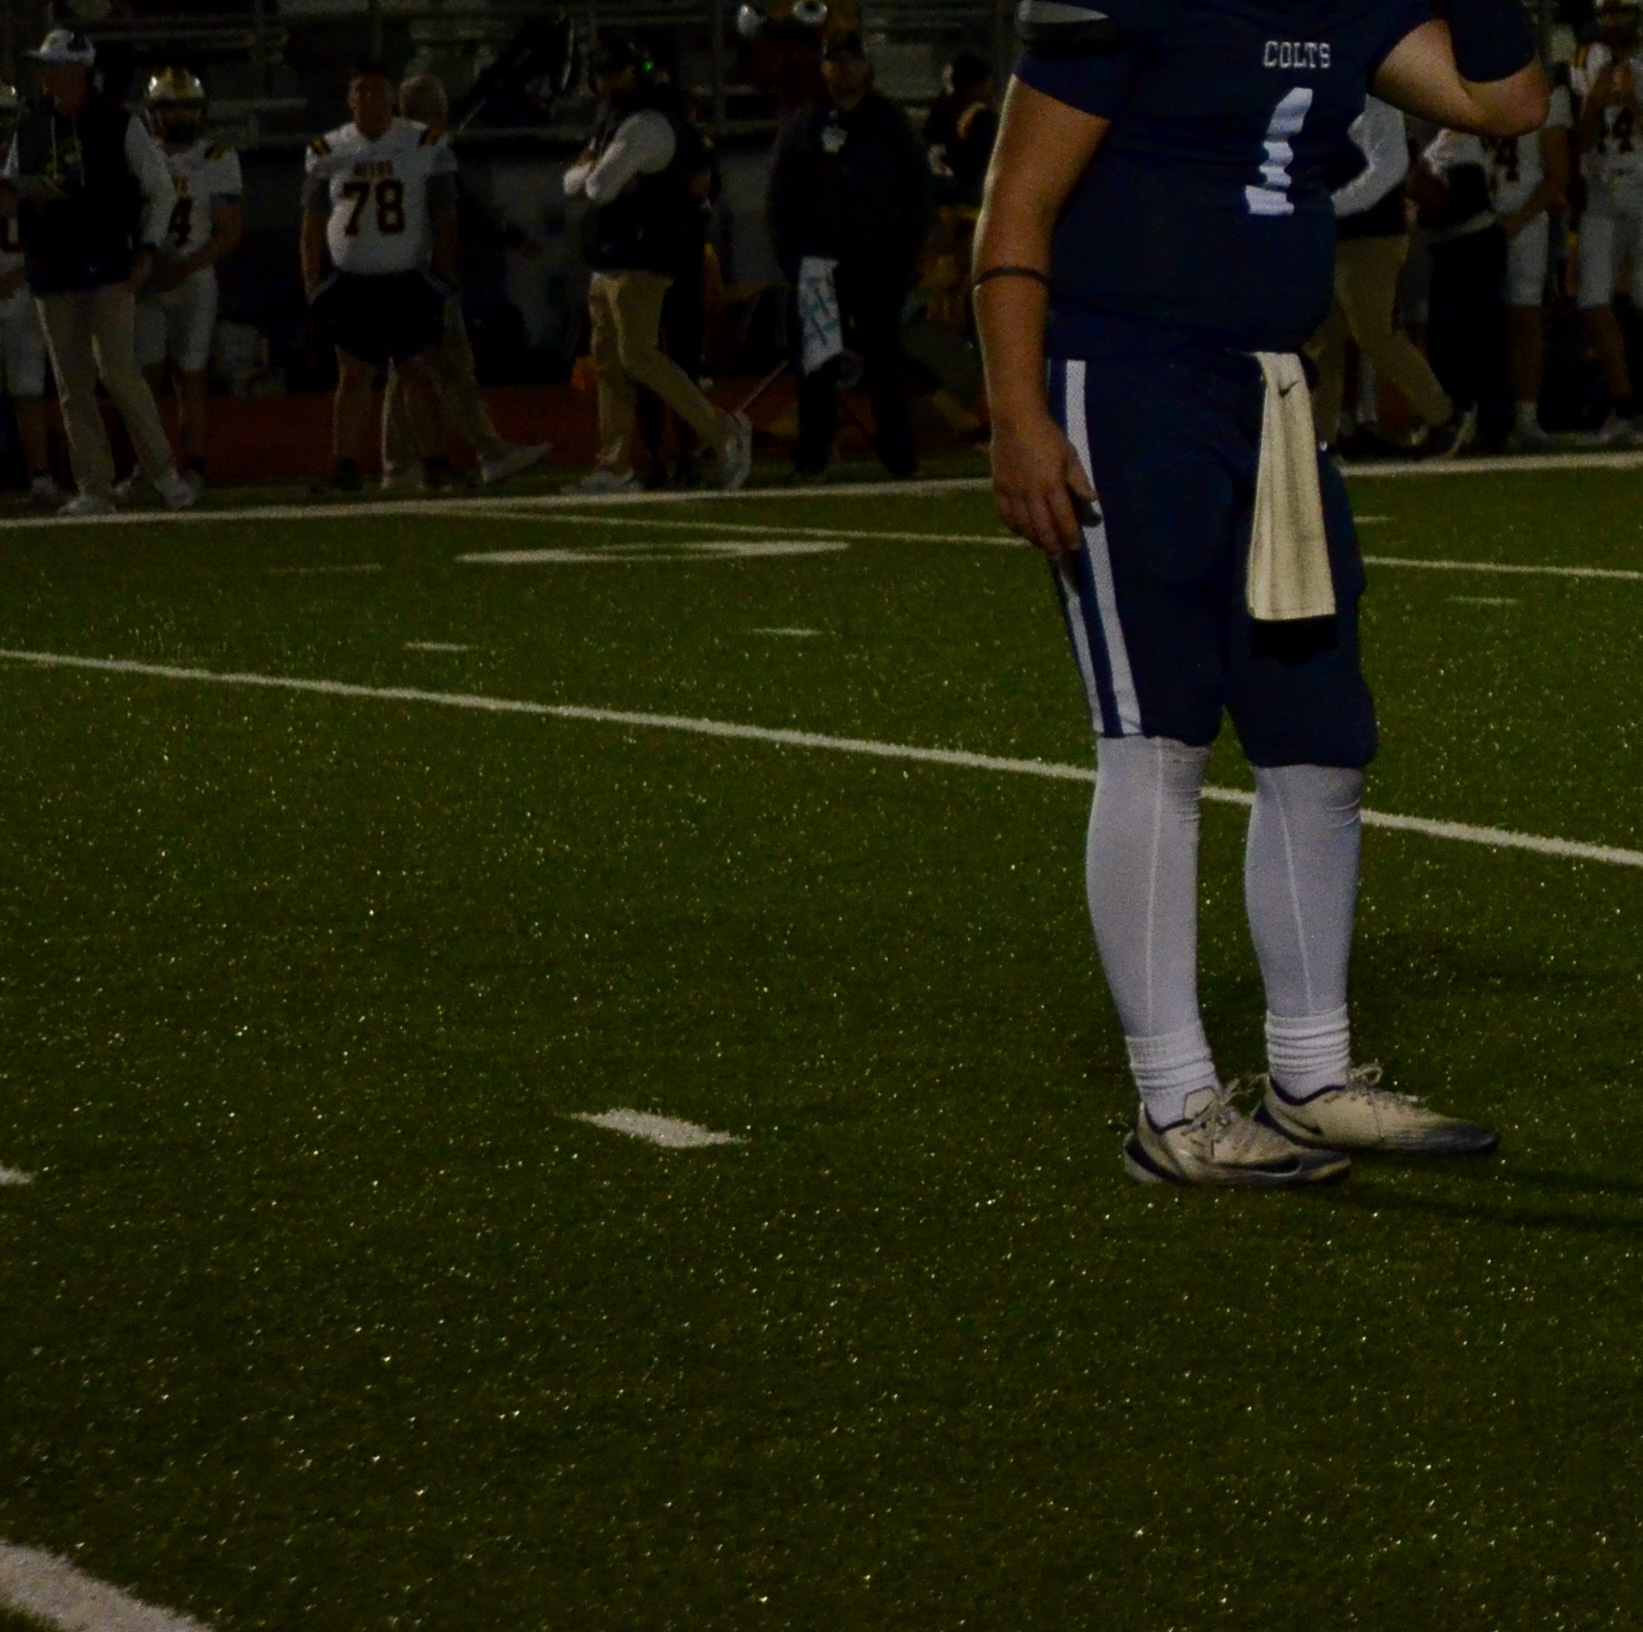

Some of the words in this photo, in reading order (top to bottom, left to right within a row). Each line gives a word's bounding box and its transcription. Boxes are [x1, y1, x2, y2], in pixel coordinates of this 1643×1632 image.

[1262, 39, 1332, 69] COLTS
[1244, 85, 1314, 216] 1
[341, 179, 405, 236] 78
